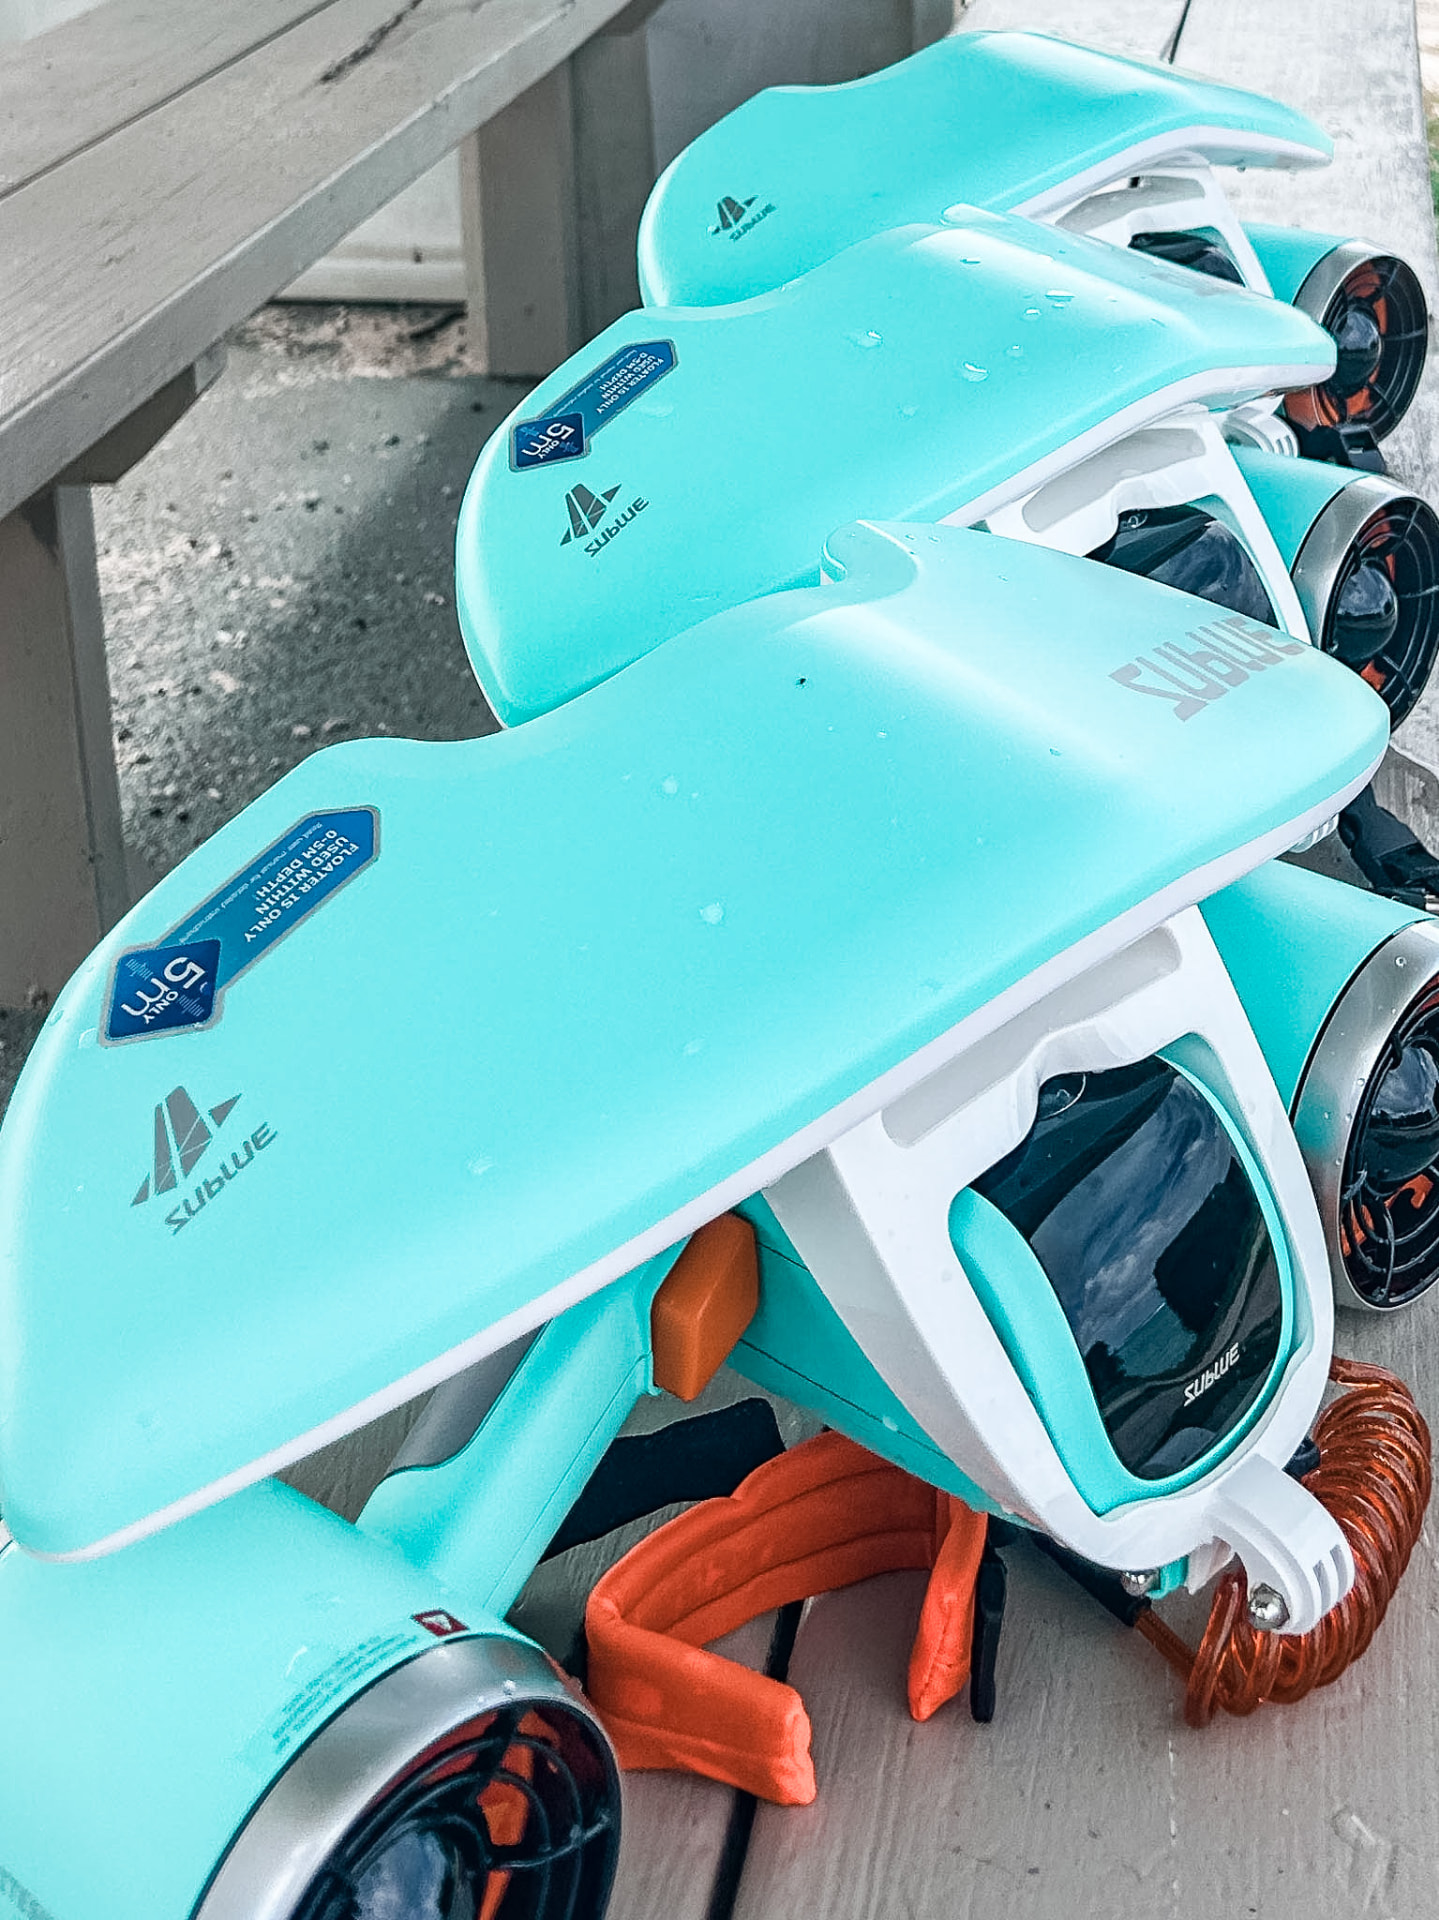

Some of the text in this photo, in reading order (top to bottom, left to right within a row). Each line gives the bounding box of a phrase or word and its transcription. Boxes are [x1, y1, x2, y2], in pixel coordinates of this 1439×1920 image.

[521, 423, 575, 456] 5m
[302, 830, 338, 858] 0-5M
[244, 842, 360, 942] FLOATER IS ONLY
[255, 836, 349, 914] USED WITHIN
[121, 957, 206, 1016] 5m
[142, 990, 179, 1024] ONLY
